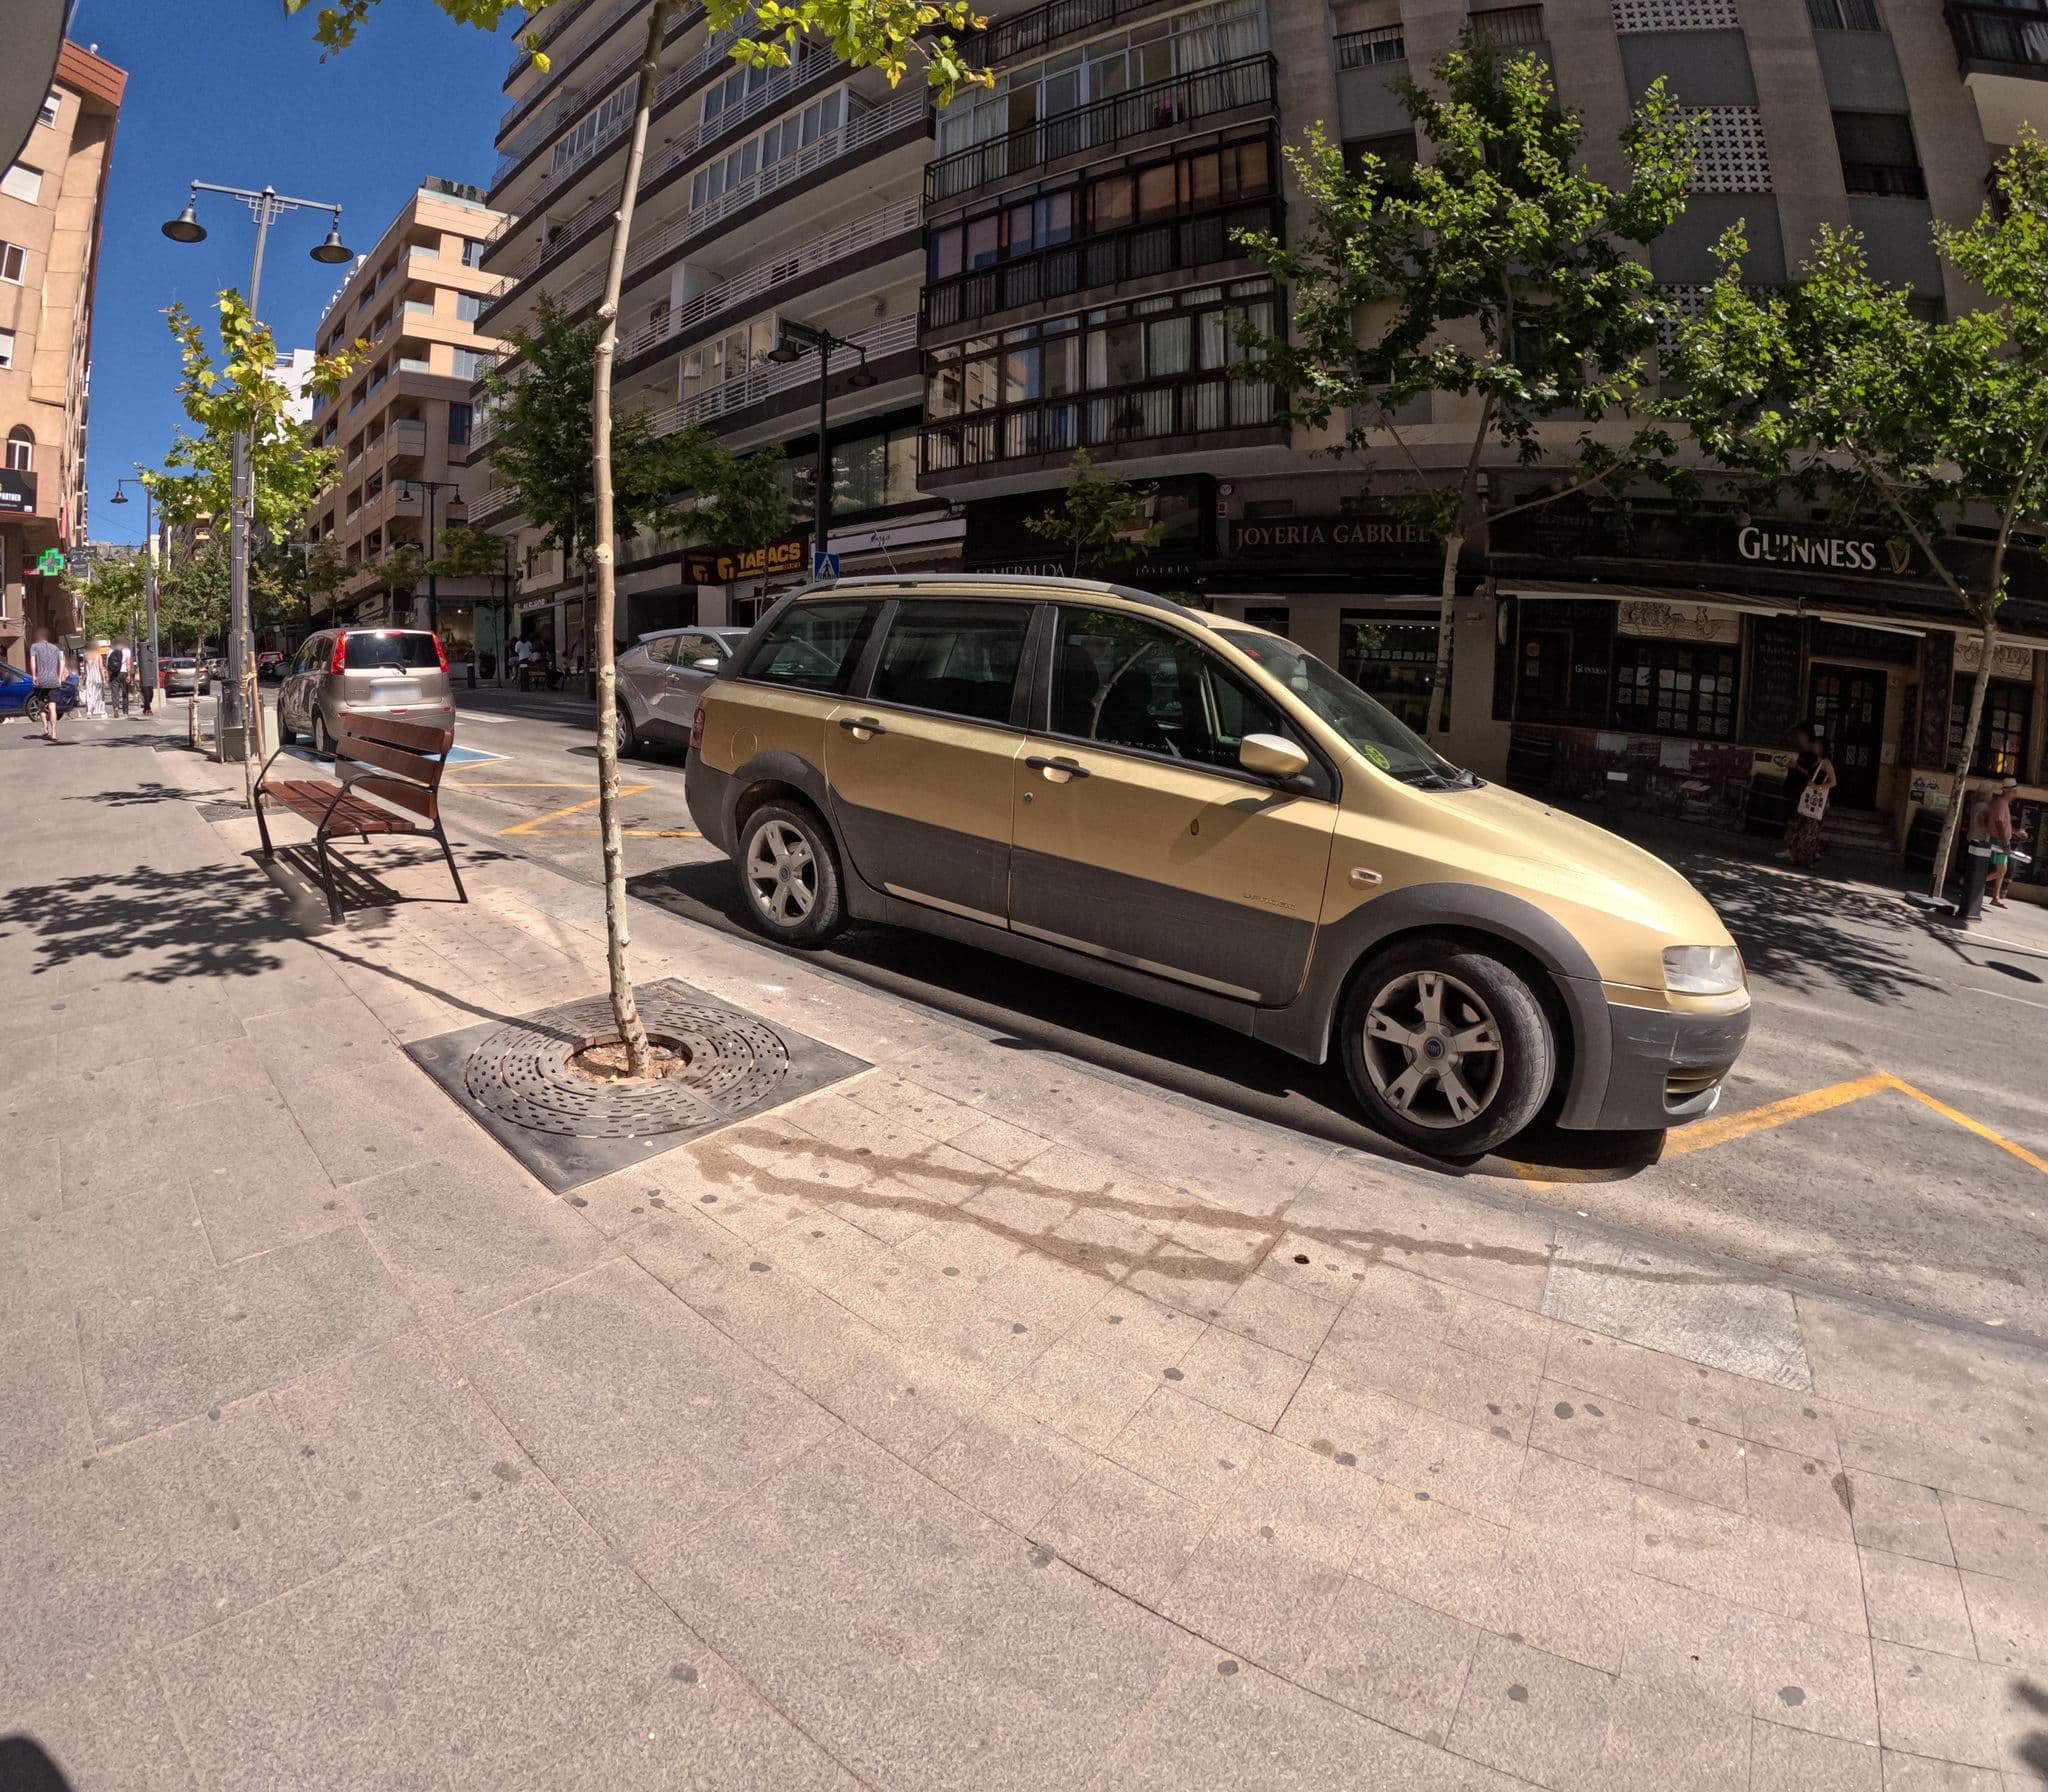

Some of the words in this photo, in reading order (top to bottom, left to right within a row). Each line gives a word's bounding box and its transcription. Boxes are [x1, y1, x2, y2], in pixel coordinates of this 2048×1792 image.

[1235, 526, 1325, 551] JOYERIA
[1333, 523, 1431, 544] GABRIEL
[1737, 526, 1877, 570] GUINNESS
[736, 541, 801, 569] TABACS
